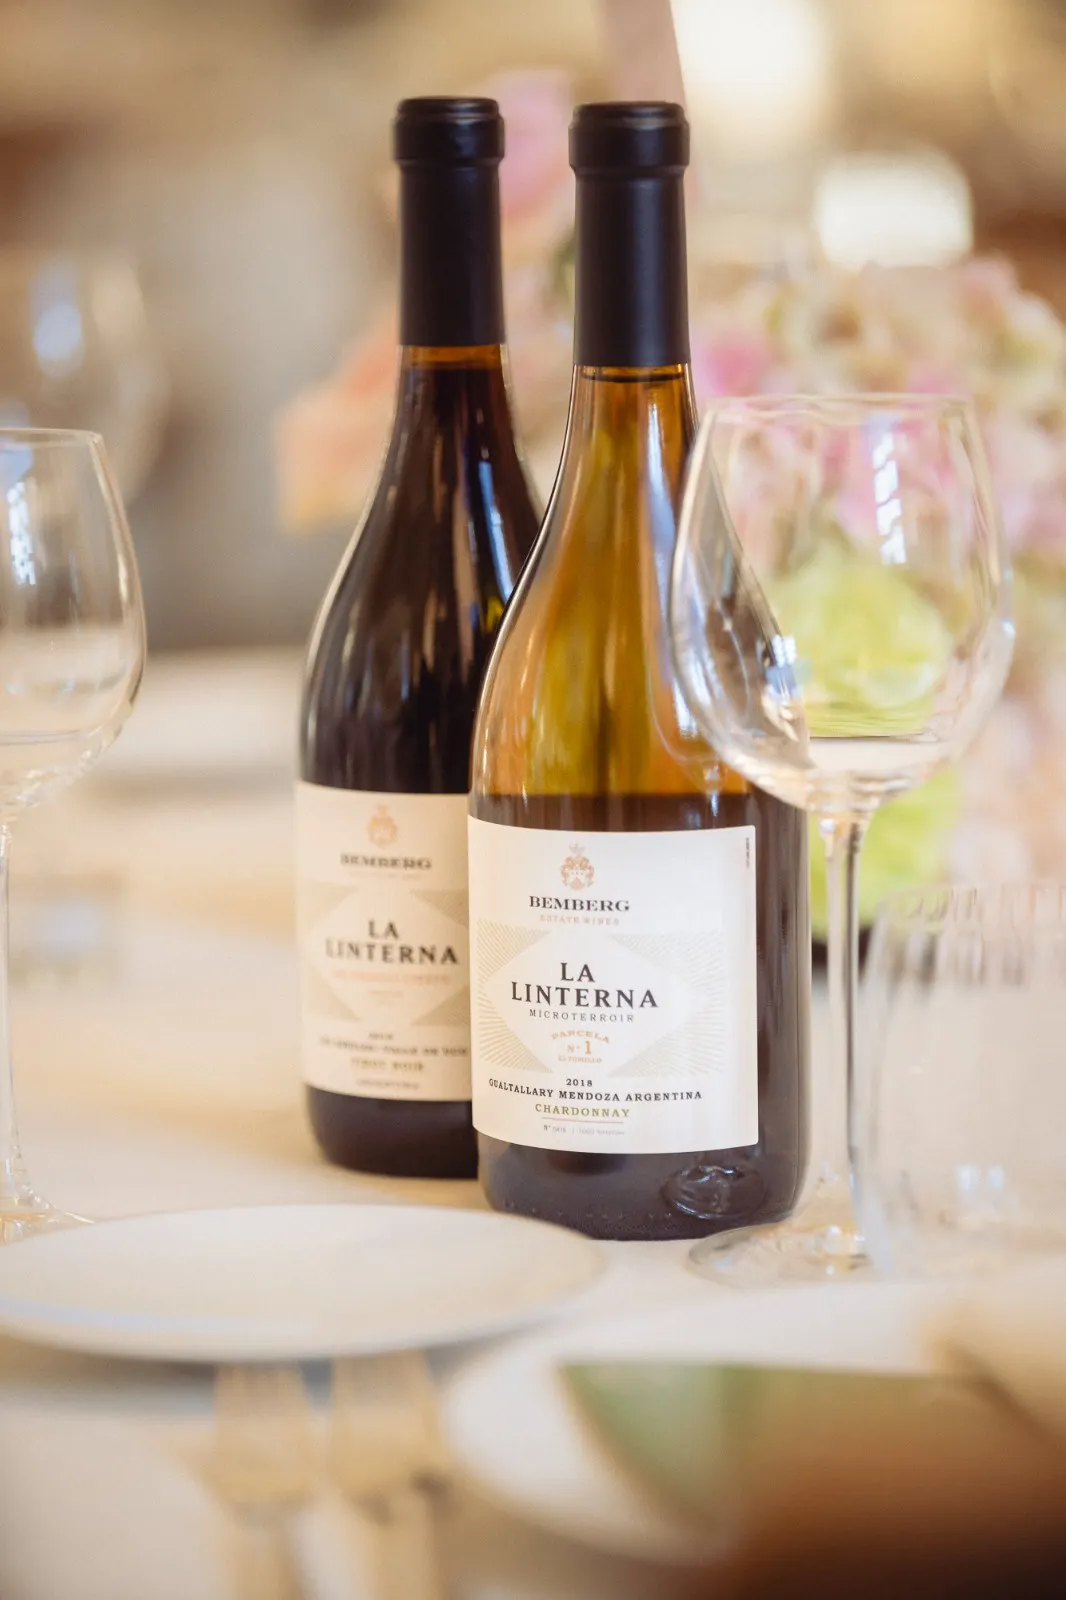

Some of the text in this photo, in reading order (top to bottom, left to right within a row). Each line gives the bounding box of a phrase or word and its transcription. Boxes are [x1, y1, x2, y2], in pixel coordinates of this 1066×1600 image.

[529, 896, 630, 911] BEMBERG
[368, 919, 399, 939] LA
[325, 937, 460, 965] LINTERNA
[560, 962, 596, 982] LA
[511, 981, 659, 1008] LINTERNA
[529, 1009, 634, 1023] MICROTERROIR
[551, 1029, 610, 1043] PARCELA
[584, 1040, 592, 1055] 1
[489, 1078, 702, 1102] GUALTALLARY MENDOZA ARGENTINA
[566, 1078, 593, 1087] 2018
[535, 1104, 631, 1118] CHARDONNAY
